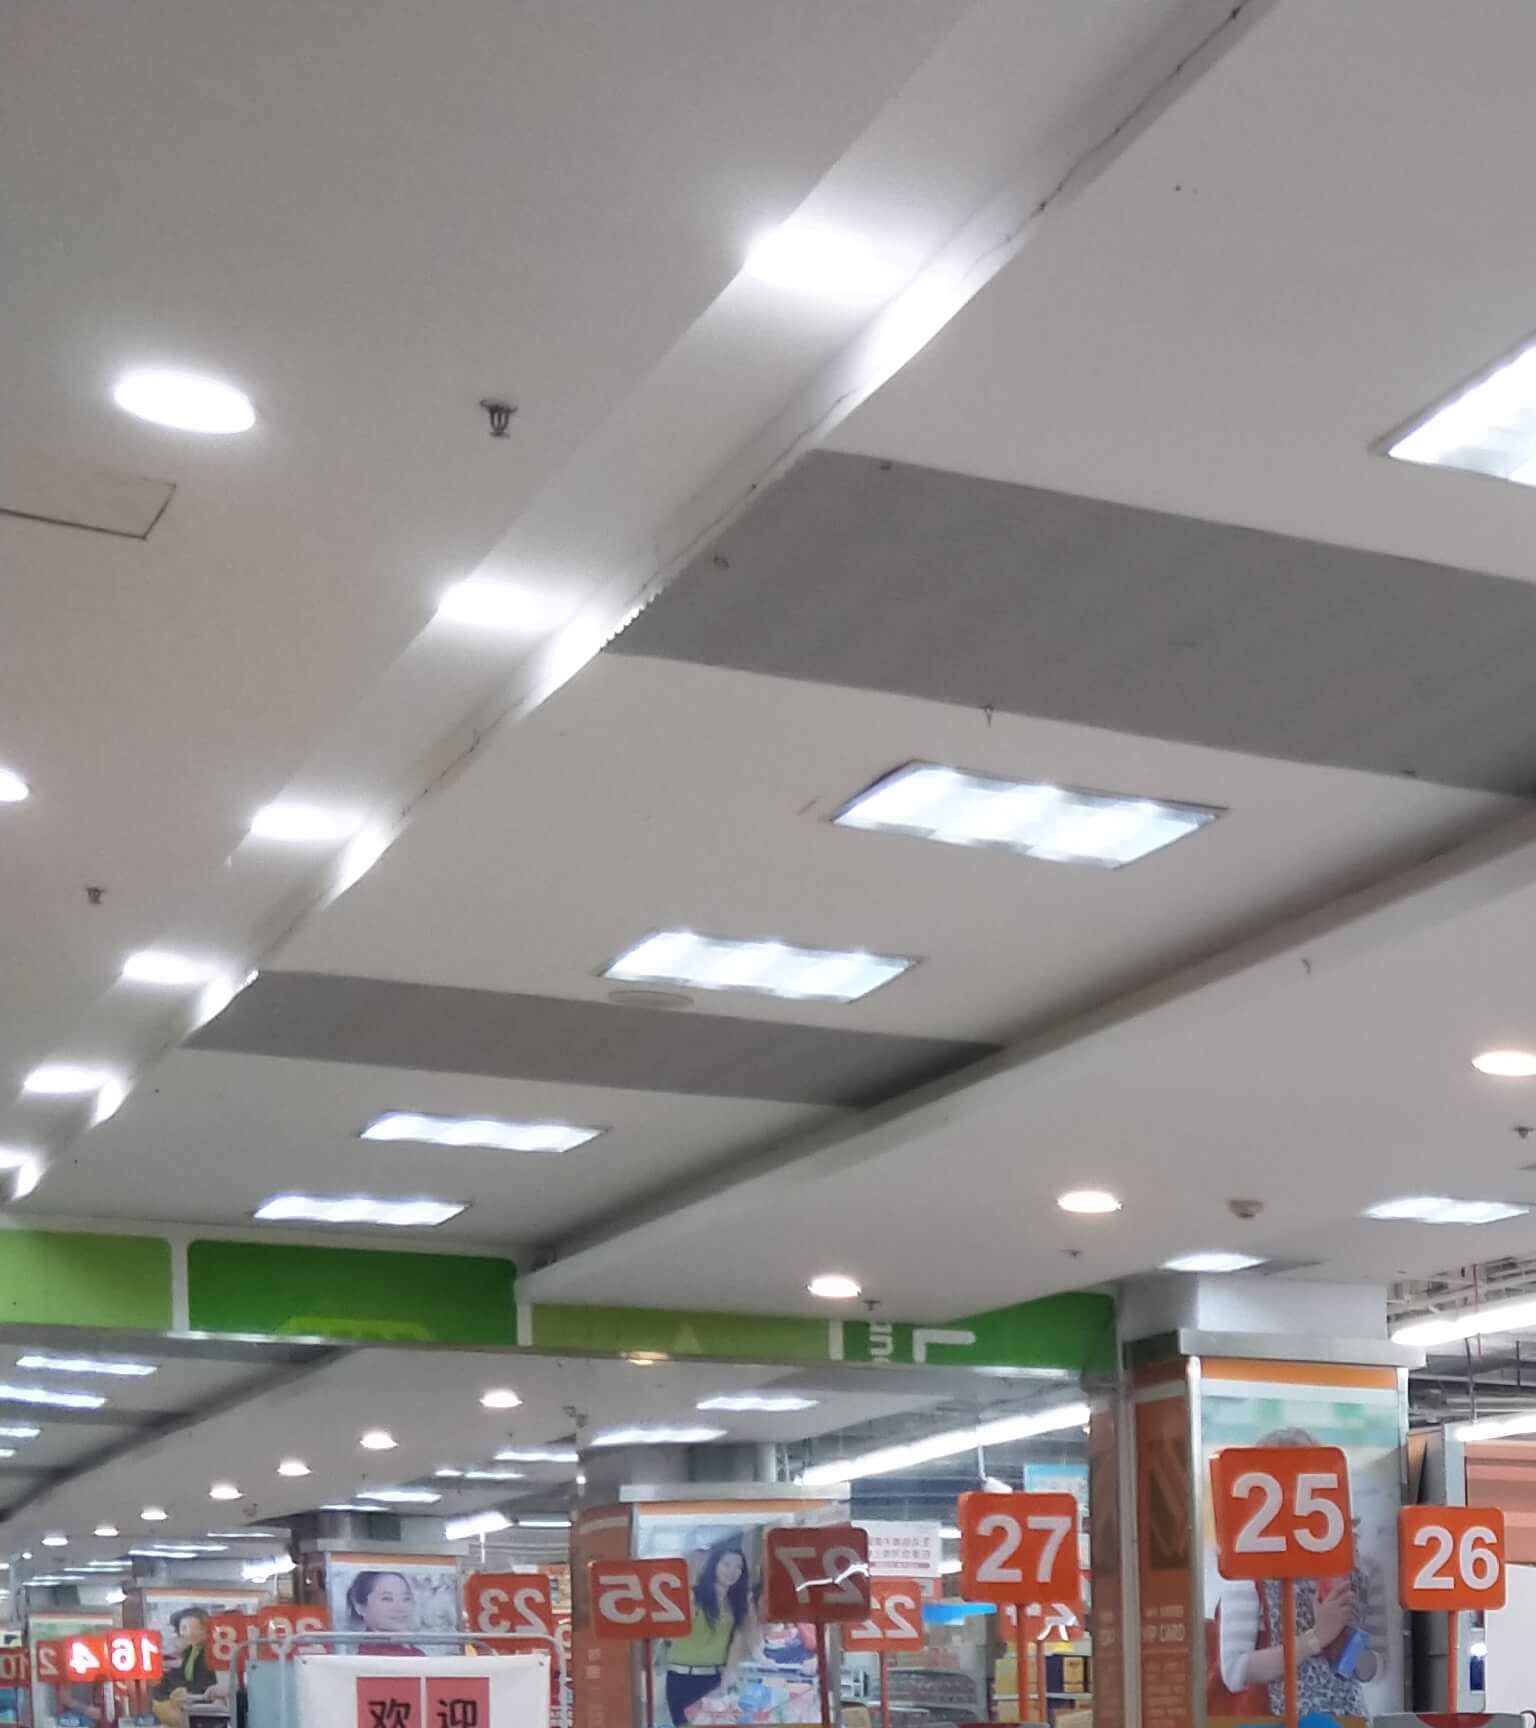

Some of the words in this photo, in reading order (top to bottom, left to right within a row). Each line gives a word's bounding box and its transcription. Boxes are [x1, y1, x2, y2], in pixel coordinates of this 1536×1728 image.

[1231, 1472, 1345, 1553] 25
[976, 1515, 1072, 1583] 27
[1411, 1525, 1500, 1590] 26
